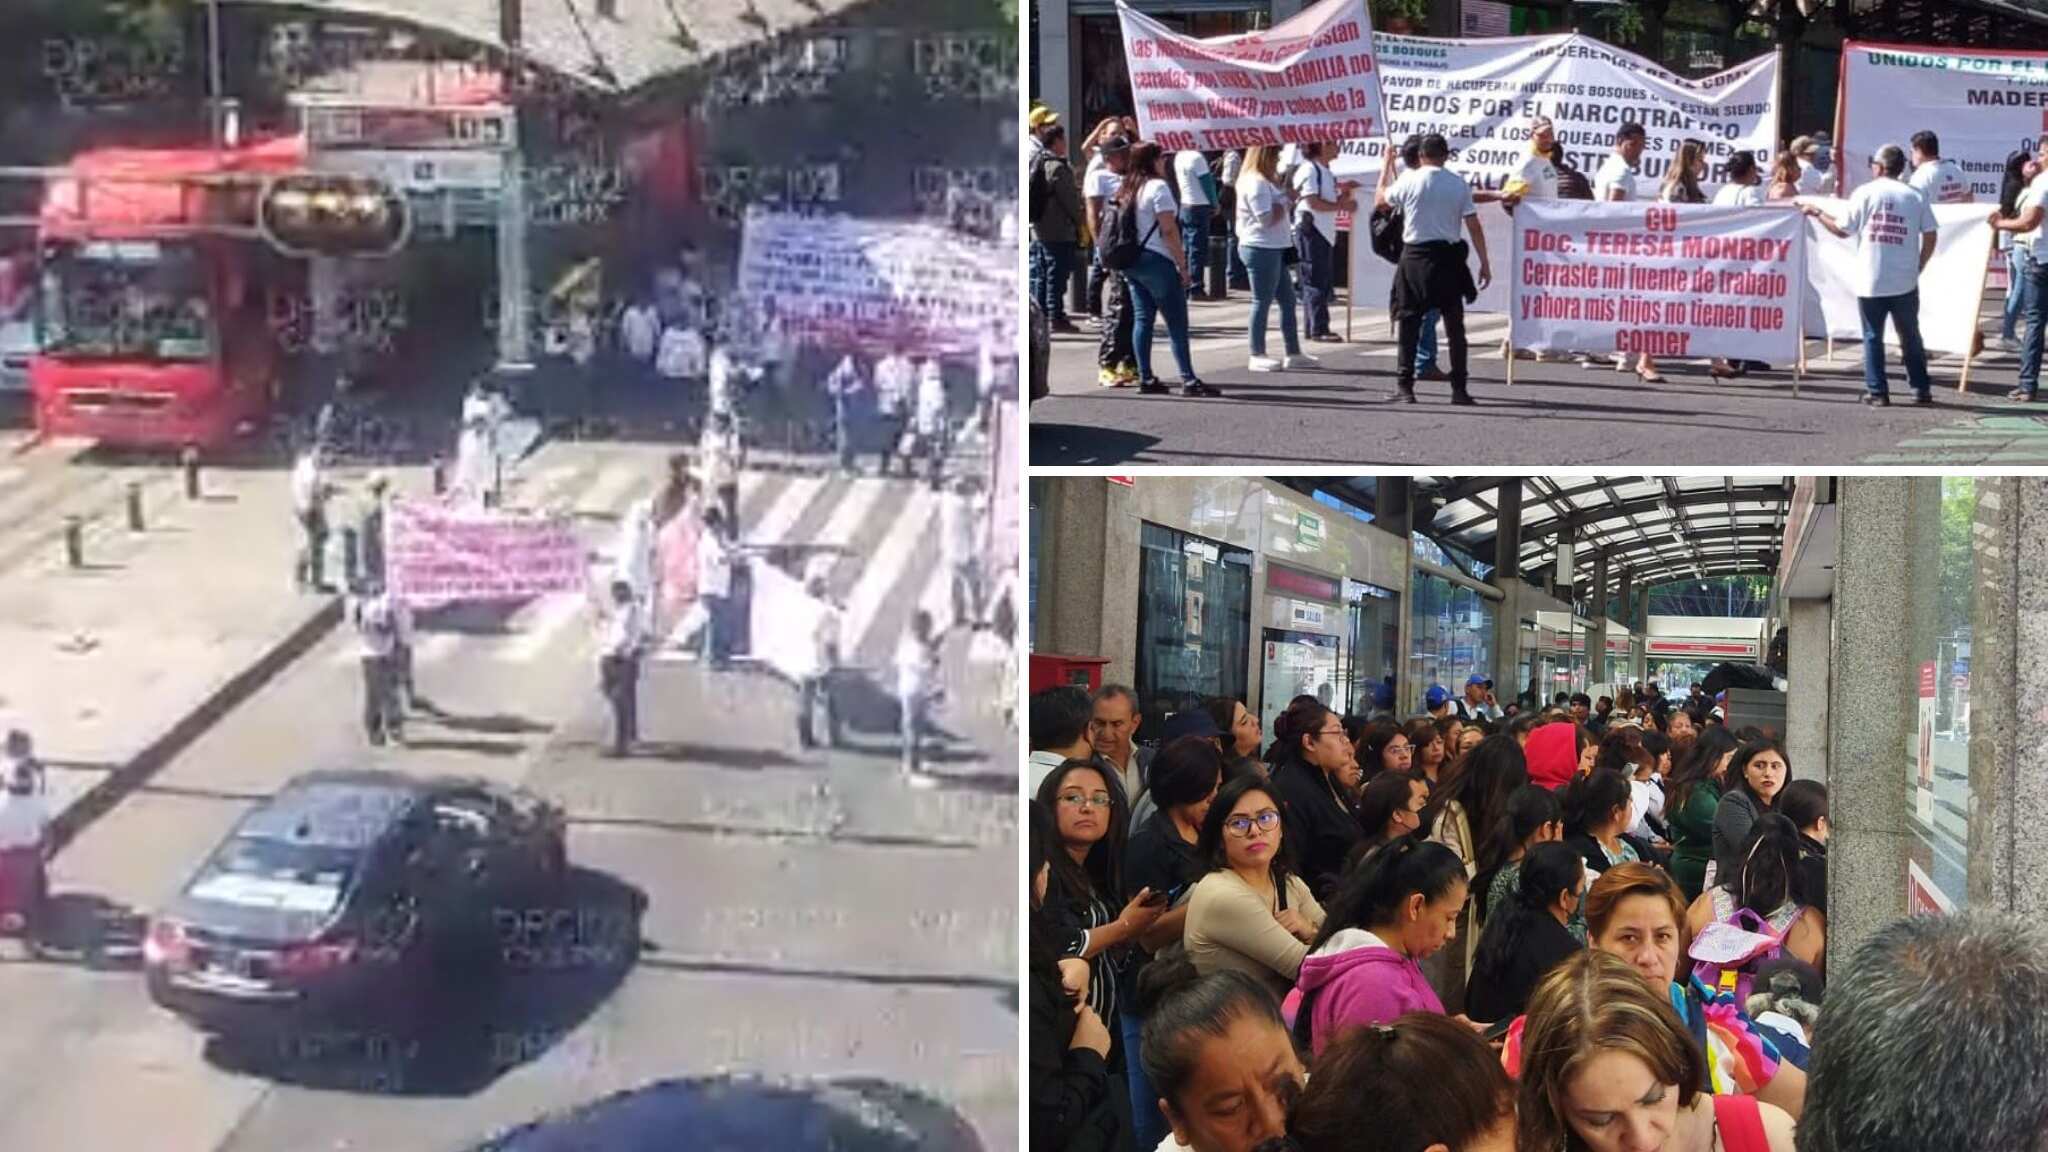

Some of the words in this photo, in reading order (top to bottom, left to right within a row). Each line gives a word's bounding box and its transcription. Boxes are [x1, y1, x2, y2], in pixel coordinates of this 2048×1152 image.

[1284, 55, 1348, 88] FAMILIA
[1349, 53, 1372, 75] no
[1867, 51, 1948, 69] UNIDOS
[1957, 57, 2003, 71] POR
[1325, 90, 1347, 112] de
[1348, 87, 1366, 109] la
[1382, 75, 1423, 88] FAVOR
[1588, 85, 1647, 100] BOSQUES
[1468, 97, 1514, 118] POR
[1202, 124, 1276, 151] TERESA
[1278, 117, 1373, 146] MONROY
[1502, 126, 1532, 141] LOS
[1585, 231, 1674, 258] TERESA
[1682, 236, 1792, 262] MONROY
[1522, 257, 1598, 289] Cerraste
[1602, 262, 1625, 289] mi
[1629, 262, 1688, 294] fuente
[1692, 266, 1715, 294] de
[1718, 268, 1786, 298] trabajo
[1521, 297, 1534, 320] y
[1533, 291, 1580, 318] ahora
[1585, 294, 1615, 322] mis
[1618, 294, 1661, 326] hijos
[1665, 301, 1686, 326] no
[1690, 298, 1746, 330] tienen
[1750, 305, 1784, 334] que
[1616, 328, 1691, 356] comer
